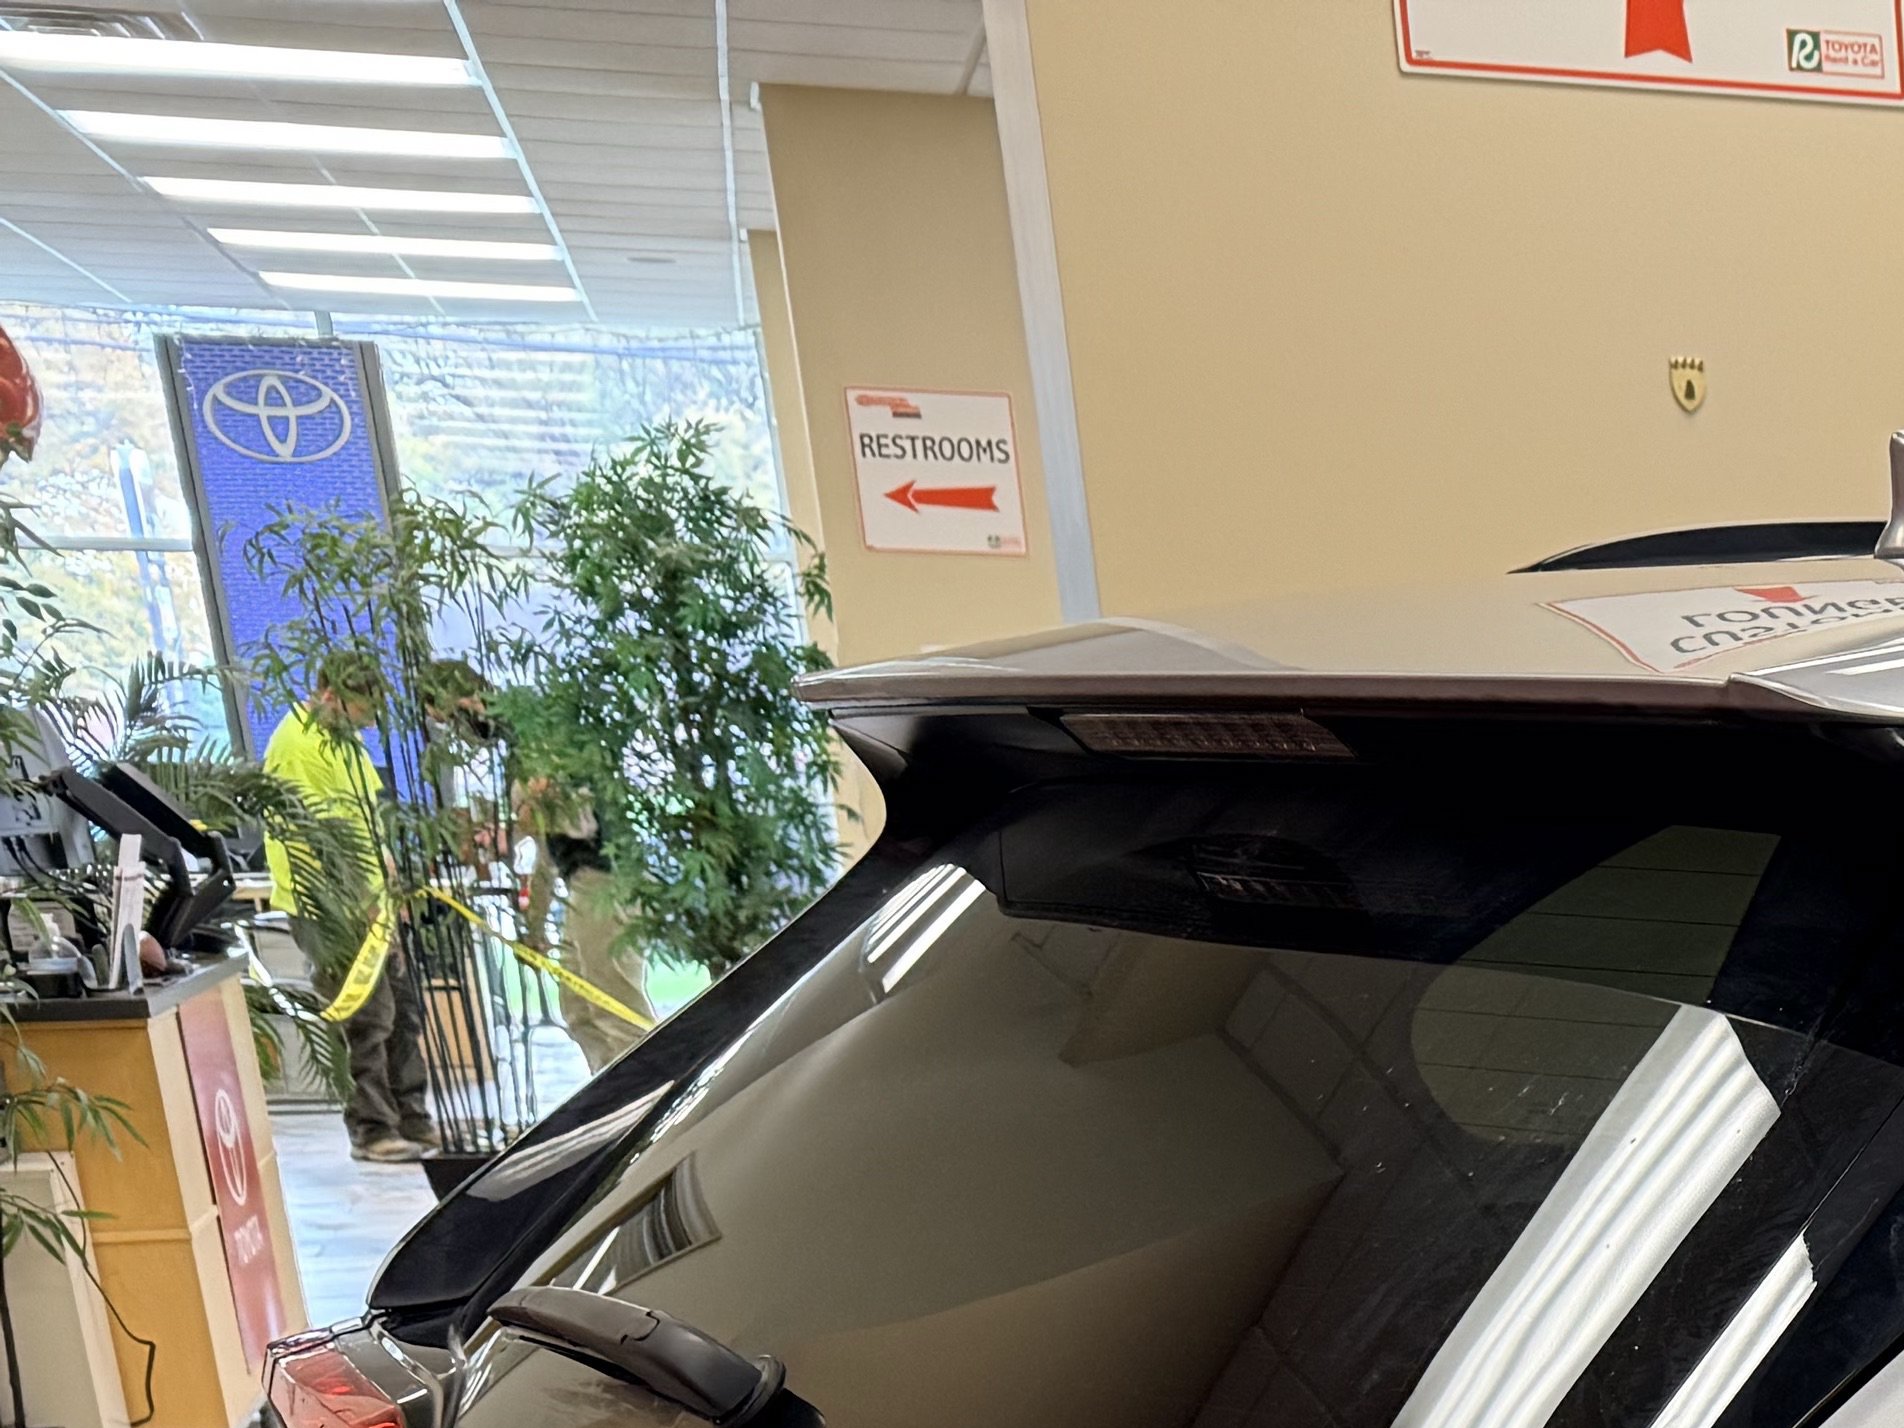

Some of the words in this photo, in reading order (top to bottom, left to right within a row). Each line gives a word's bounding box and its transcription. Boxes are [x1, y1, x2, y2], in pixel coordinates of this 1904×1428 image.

[1824, 39, 1879, 55] TOYOTA
[1824, 54, 1849, 66] Rent
[1861, 55, 1880, 67] Car
[858, 432, 1010, 464] RESTROOMS
